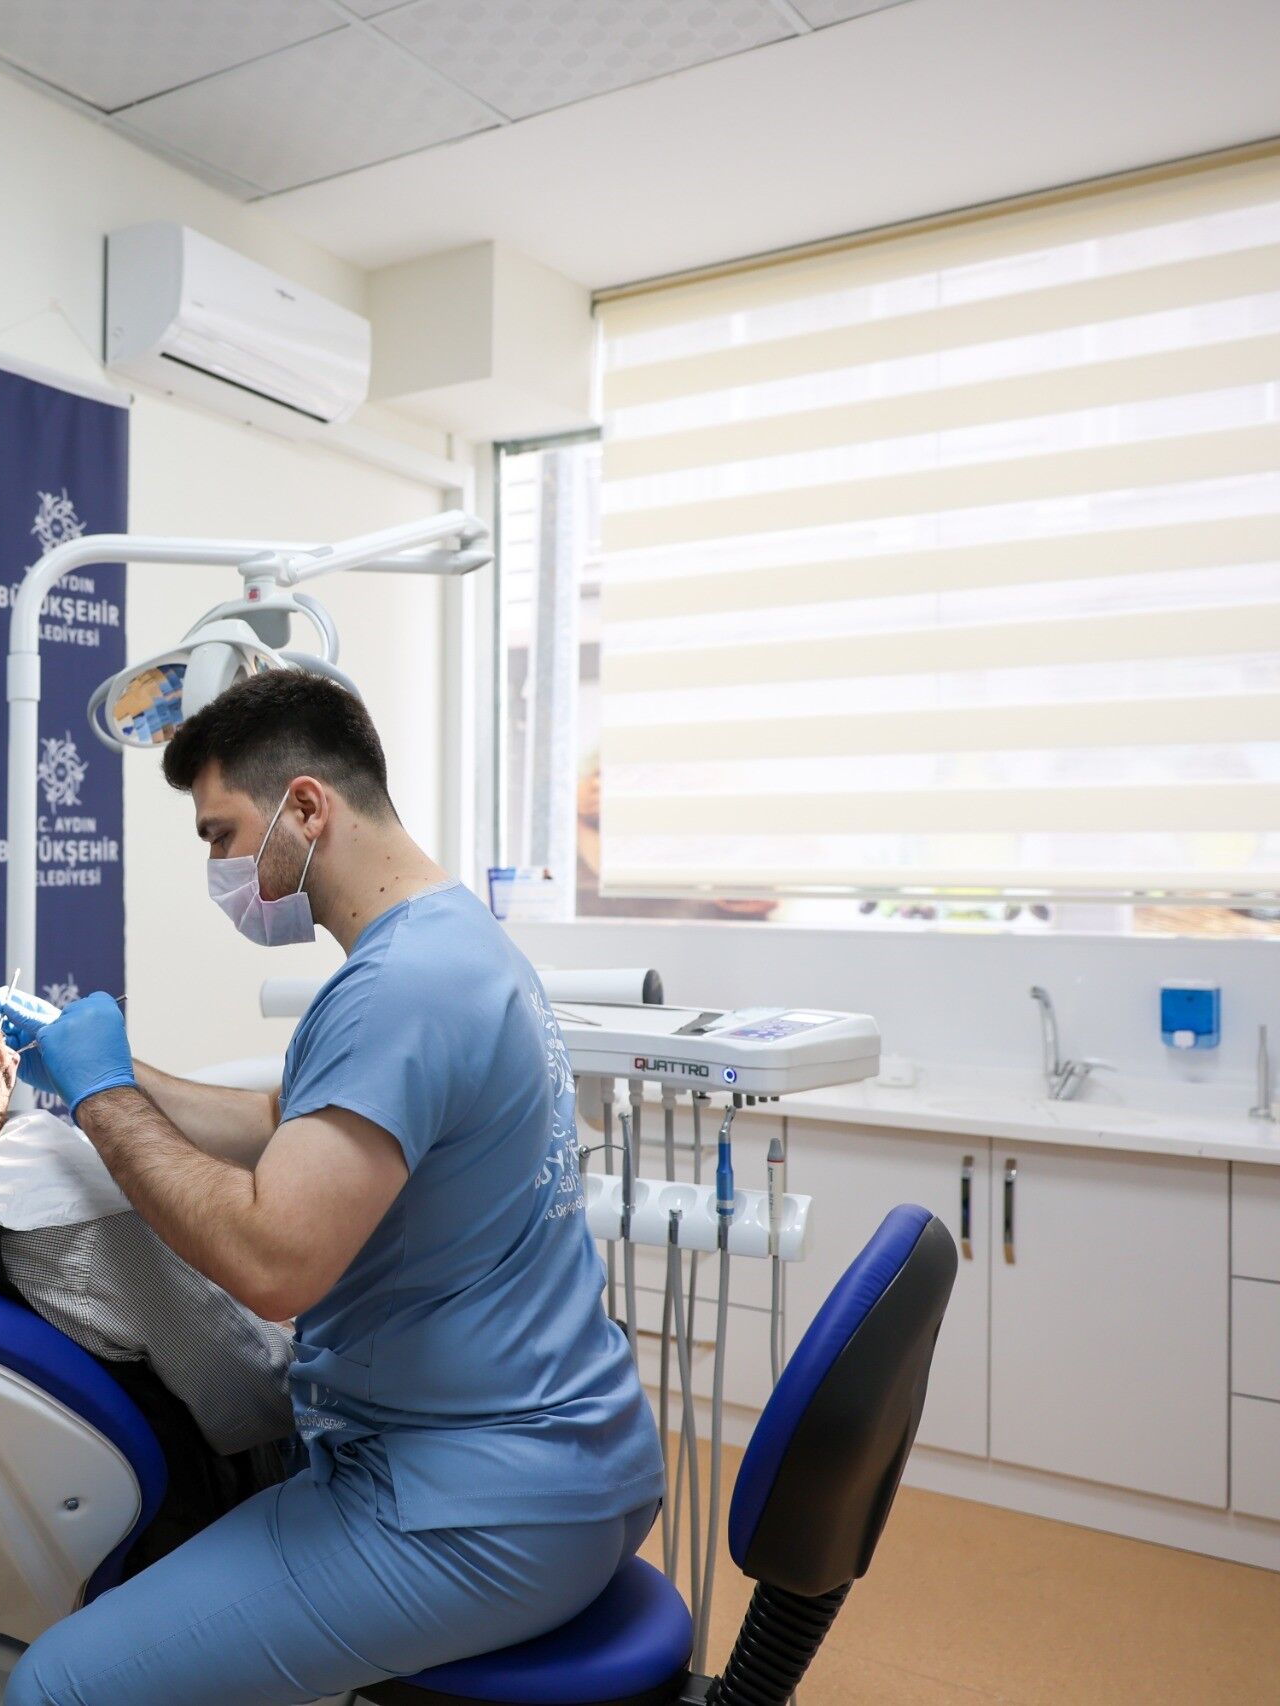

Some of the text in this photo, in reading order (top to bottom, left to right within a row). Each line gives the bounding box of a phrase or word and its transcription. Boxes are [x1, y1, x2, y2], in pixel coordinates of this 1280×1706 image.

[39, 622, 100, 647] LEDİYESİ
[54, 816, 97, 833] AYDIN
[634, 1057, 709, 1078] QUATTRO
